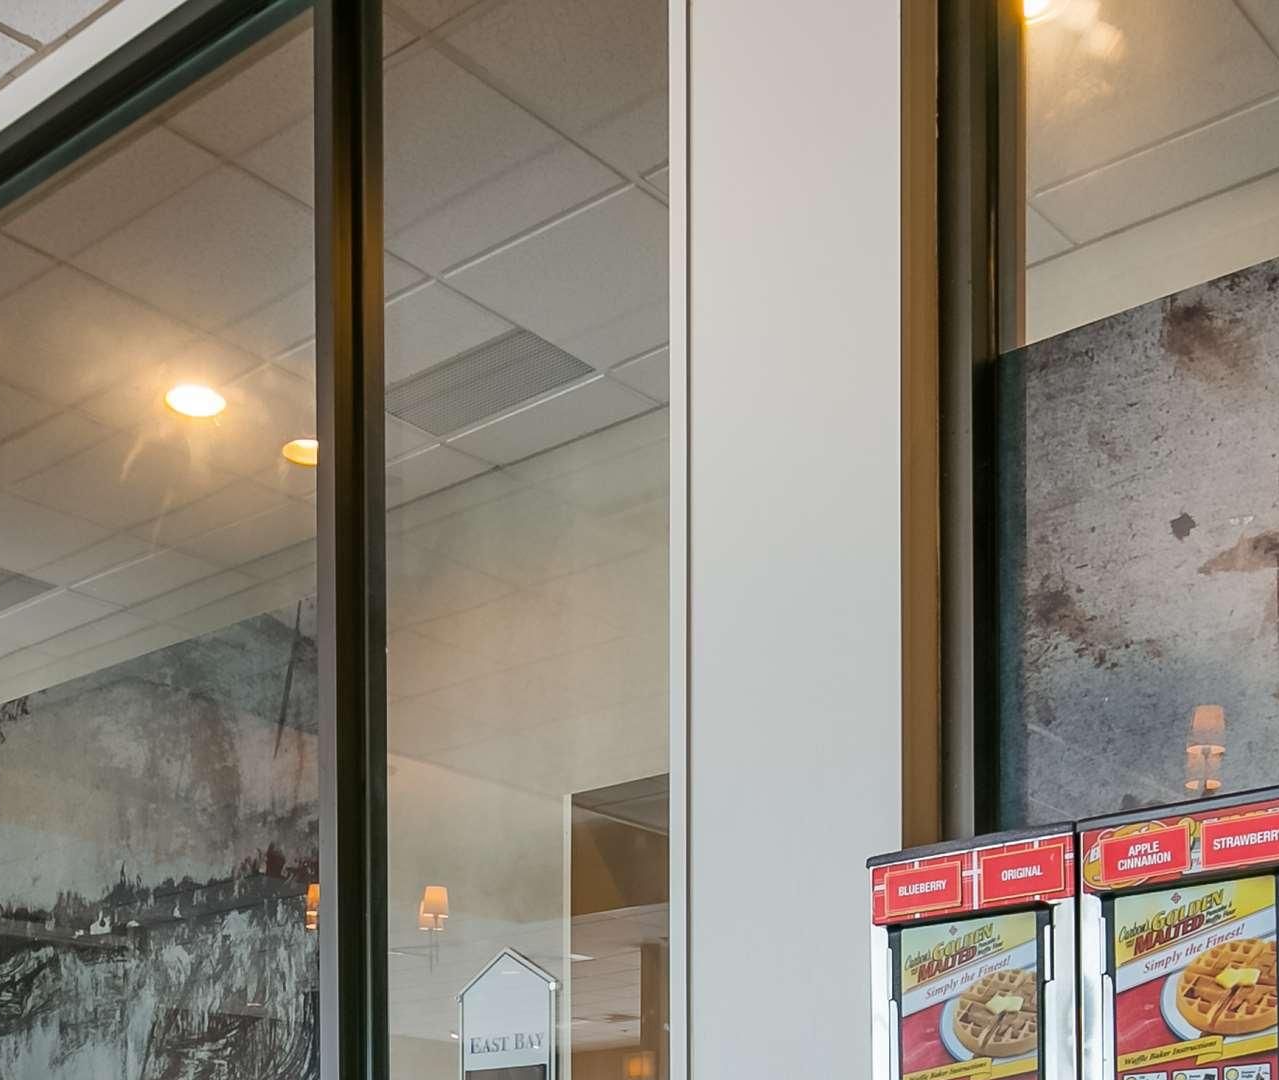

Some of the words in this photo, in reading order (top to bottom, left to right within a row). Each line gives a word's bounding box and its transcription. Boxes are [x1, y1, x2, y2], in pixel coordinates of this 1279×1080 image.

[1117, 851, 1172, 871] CINNAMON
[1128, 840, 1160, 857] APPLE
[1001, 865, 1043, 882] ORIGINAL
[898, 879, 947, 897] BLUEBERRY
[1151, 888, 1224, 931] GOLDEN
[932, 923, 994, 960] GOLDEN
[1134, 913, 1205, 956] MALTED
[1144, 950, 1182, 974] Simply
[1185, 942, 1202, 957] the
[1206, 922, 1245, 948] Finest!
[917, 946, 977, 983] MALTED
[926, 978, 960, 999] Simply
[961, 971, 975, 984] the
[1124, 1055, 1148, 1065] Waffle
[1149, 1050, 1171, 1060] Baker
